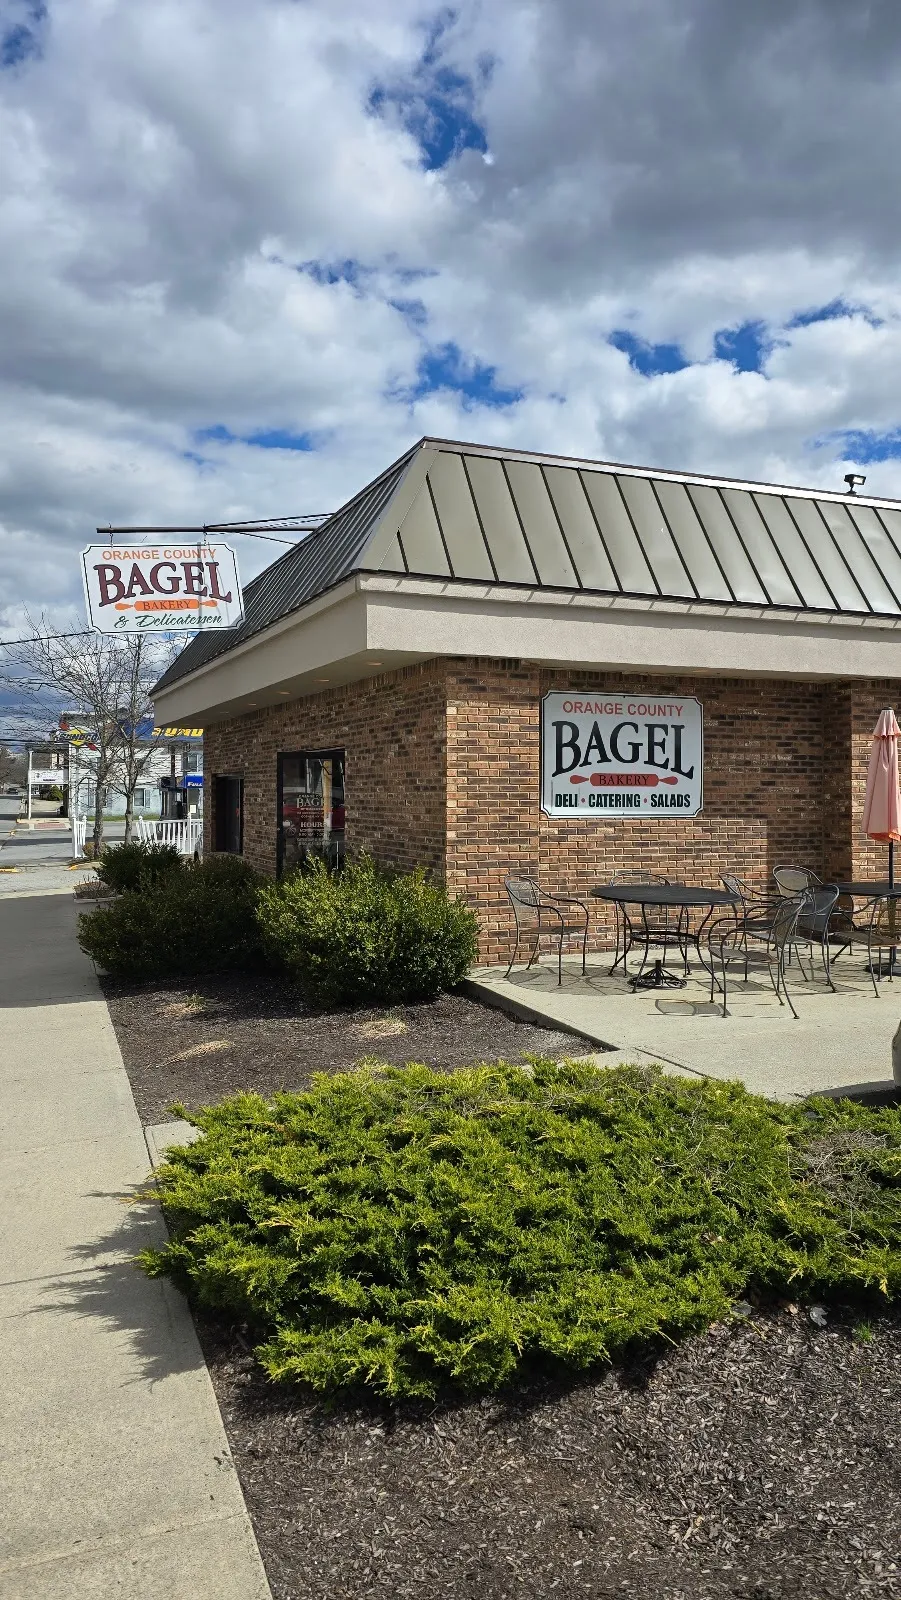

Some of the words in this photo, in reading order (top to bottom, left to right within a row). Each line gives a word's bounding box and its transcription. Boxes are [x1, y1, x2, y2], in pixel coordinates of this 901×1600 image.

[102, 550, 160, 561] ORANGE
[163, 549, 217, 560] COUNTY
[93, 562, 232, 607] BAGEL
[142, 600, 191, 610] BAKERY
[114, 615, 129, 628] &
[135, 613, 223, 628] Delicatessen
[562, 701, 623, 715] ORANGE
[628, 703, 684, 717] COUNTY
[551, 720, 695, 780] BAGEL
[598, 774, 650, 786] BAKERY
[554, 793, 578, 808] DELI
[588, 793, 641, 808] CATERING
[650, 793, 691, 808] SALADS
